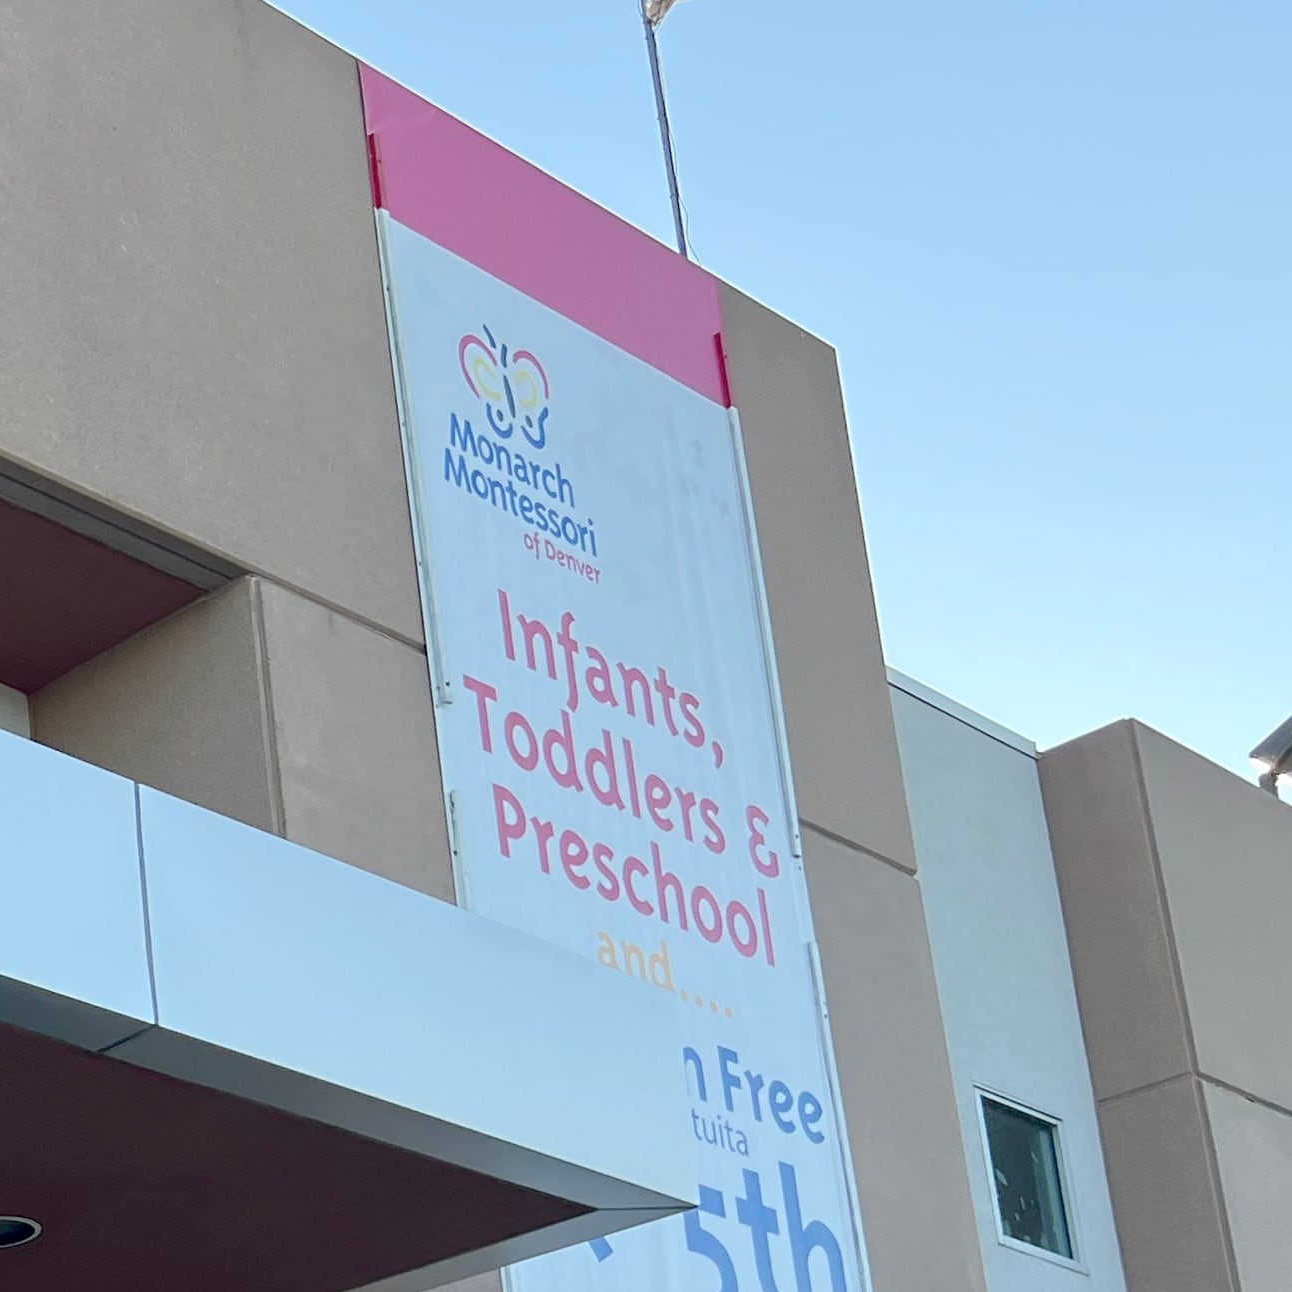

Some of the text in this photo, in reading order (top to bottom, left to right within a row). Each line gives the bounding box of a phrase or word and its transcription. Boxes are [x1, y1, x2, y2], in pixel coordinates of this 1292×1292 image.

[444, 447, 598, 557] Montessori
[449, 412, 575, 508] Monarch
[523, 532, 601, 583] of Denver
[497, 588, 724, 769] Infants,
[462, 674, 780, 878] Toddlers &
[492, 783, 775, 968] Preschool
[691, 1108, 749, 1157] tuita
[717, 1044, 825, 1144] Free
